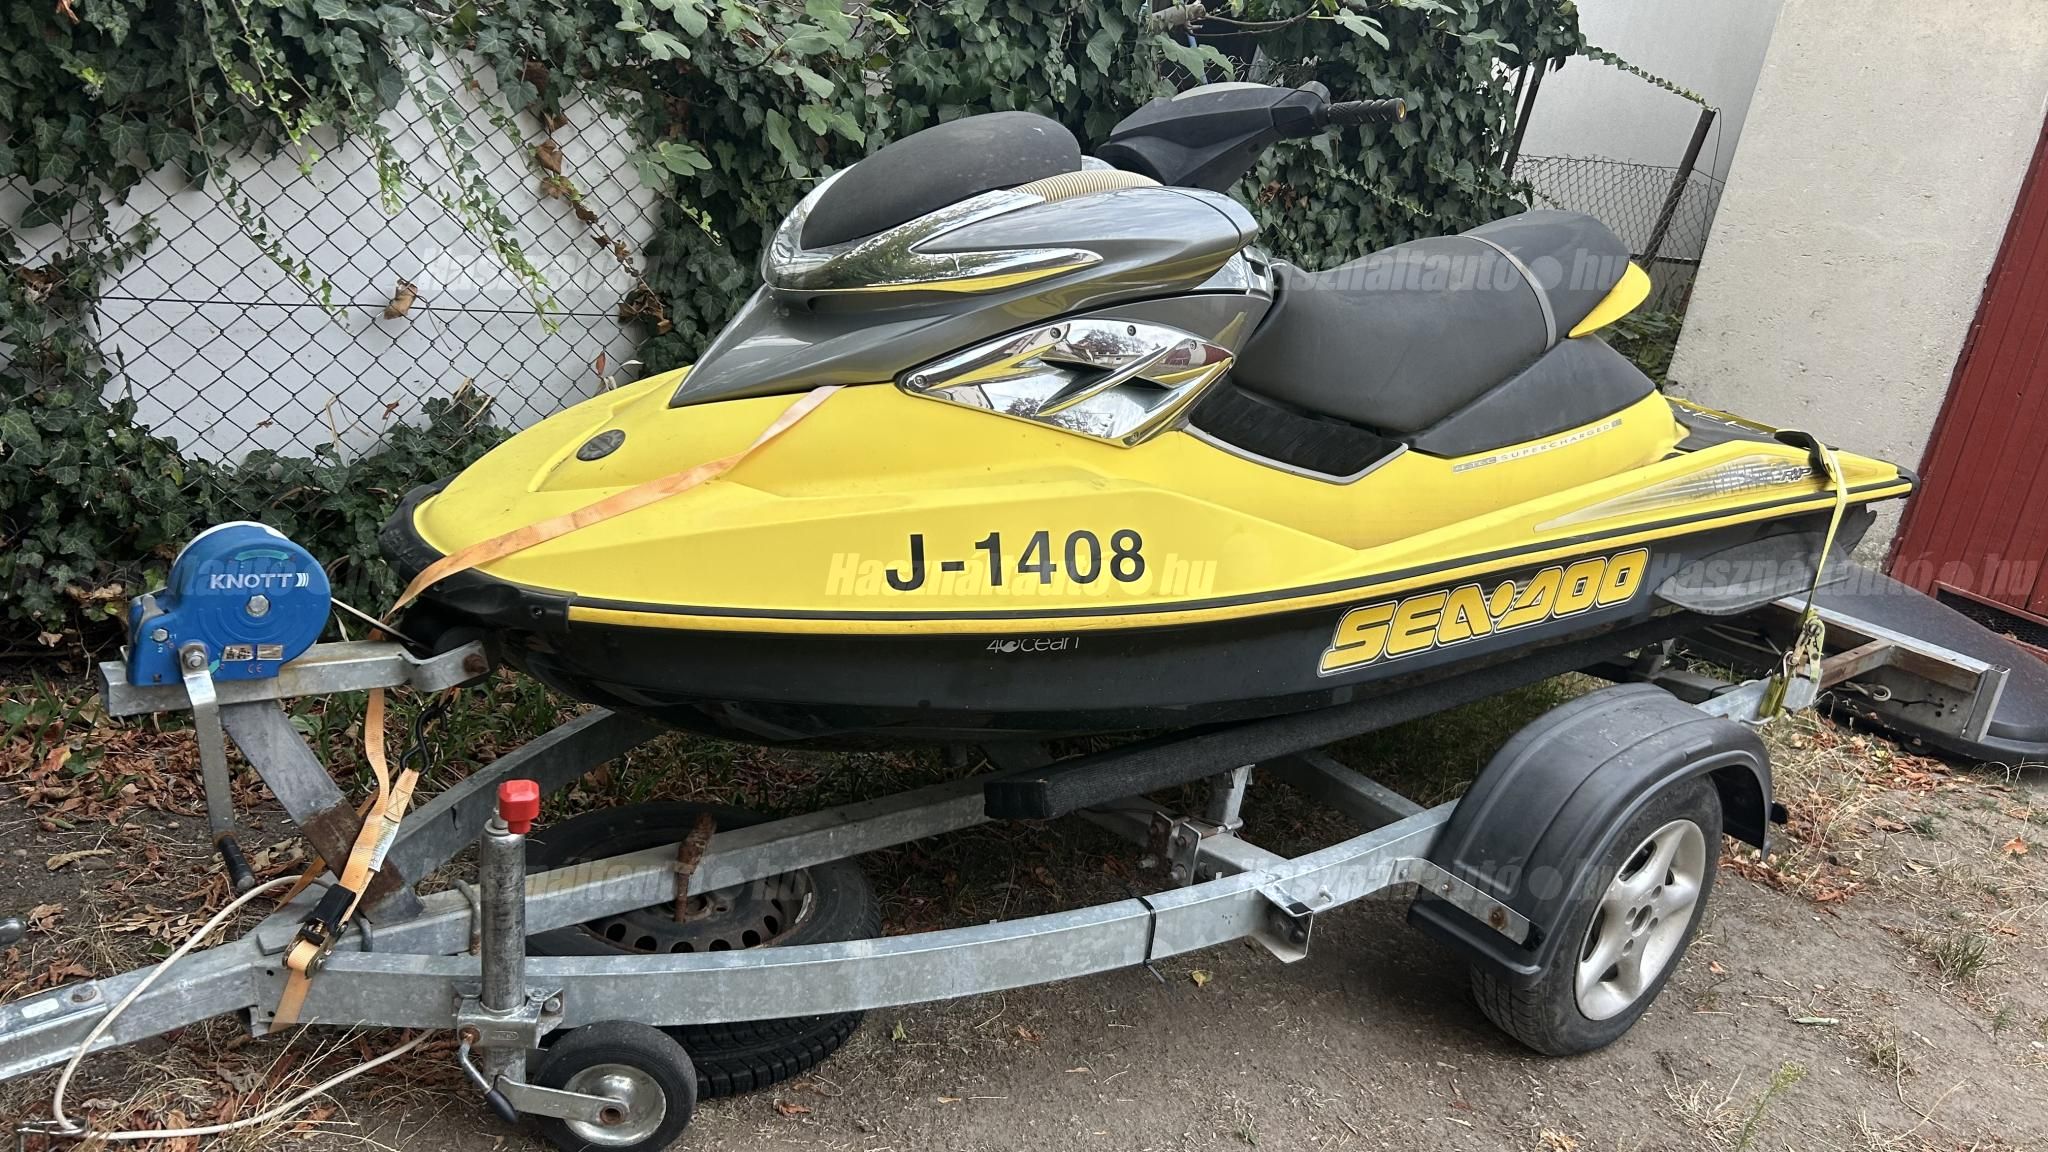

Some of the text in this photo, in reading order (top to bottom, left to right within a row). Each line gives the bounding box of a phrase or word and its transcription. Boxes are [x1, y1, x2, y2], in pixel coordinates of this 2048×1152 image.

[1500, 423, 1611, 461] SUPERCHARGED
[886, 529, 1146, 591] J-1408
[210, 572, 292, 590] KNOTT
